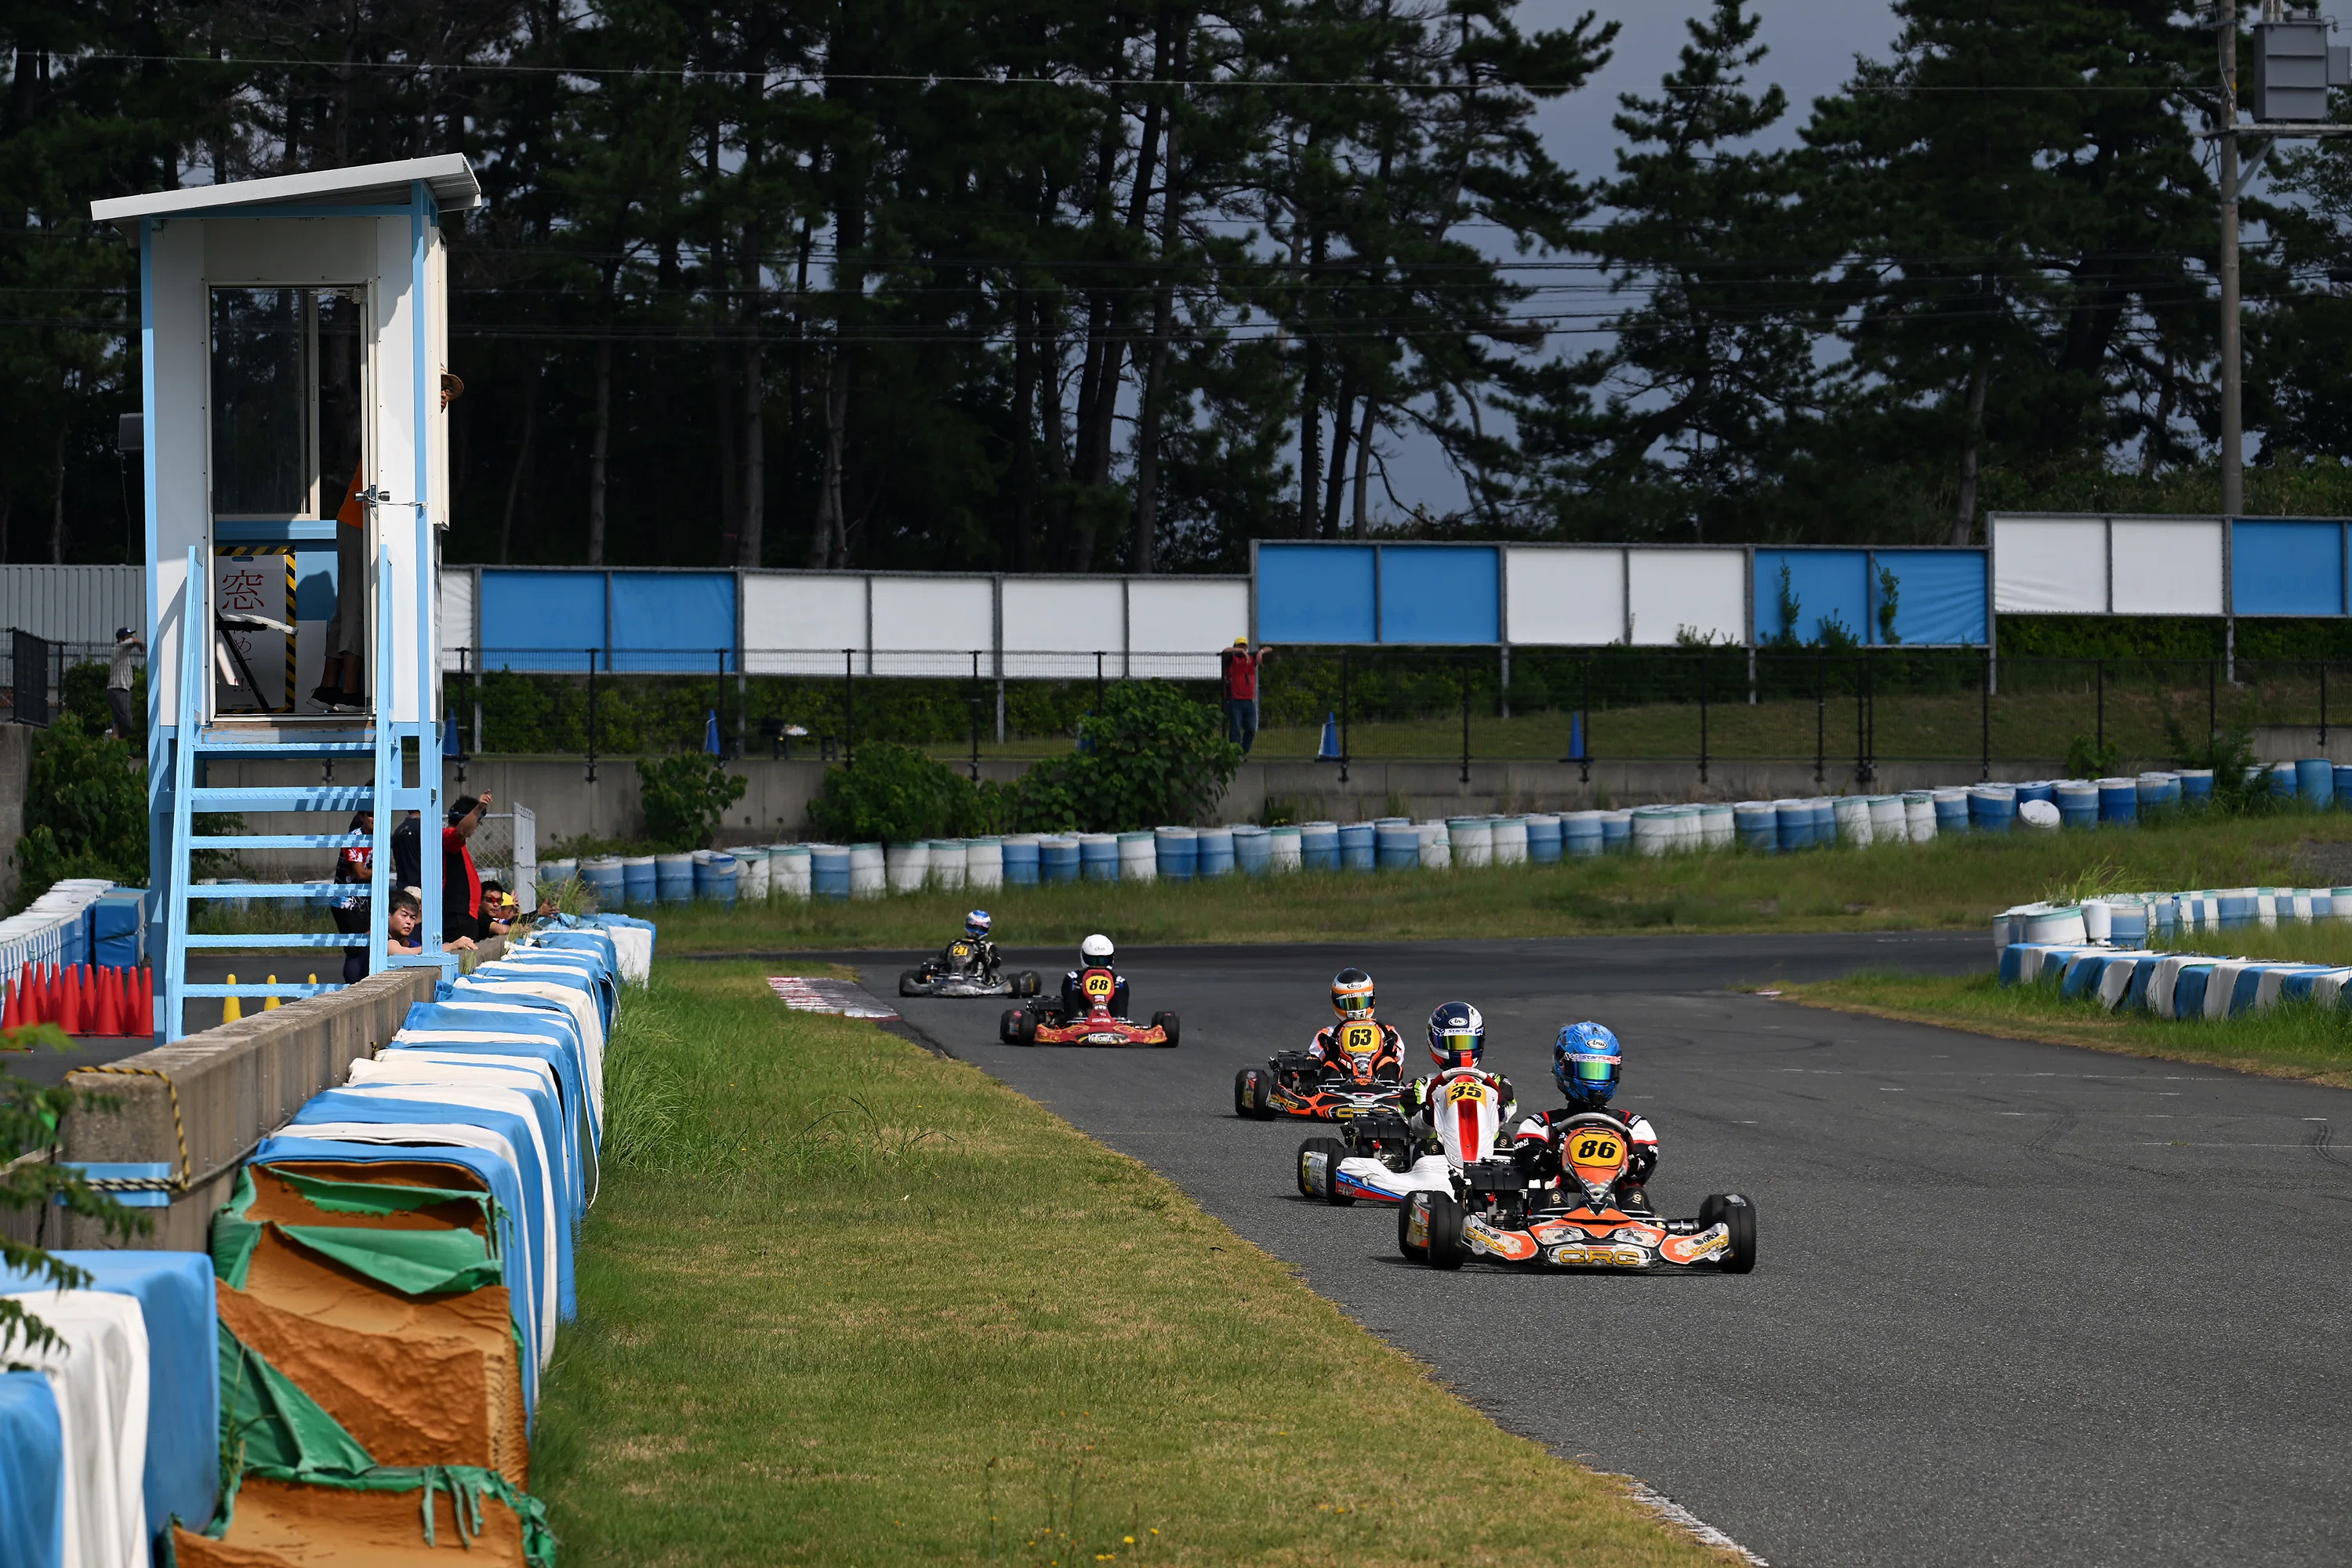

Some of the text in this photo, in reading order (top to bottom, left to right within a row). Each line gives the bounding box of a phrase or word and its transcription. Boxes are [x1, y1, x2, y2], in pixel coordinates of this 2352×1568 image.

[222, 569, 264, 610] 窓
[954, 946, 967, 955] 27
[1089, 978, 1109, 991] 88
[1349, 1029, 1372, 1047] 63
[1451, 1086, 1483, 1102] 35
[1578, 1140, 1617, 1159] 86
[1559, 1249, 1640, 1265] CRG
